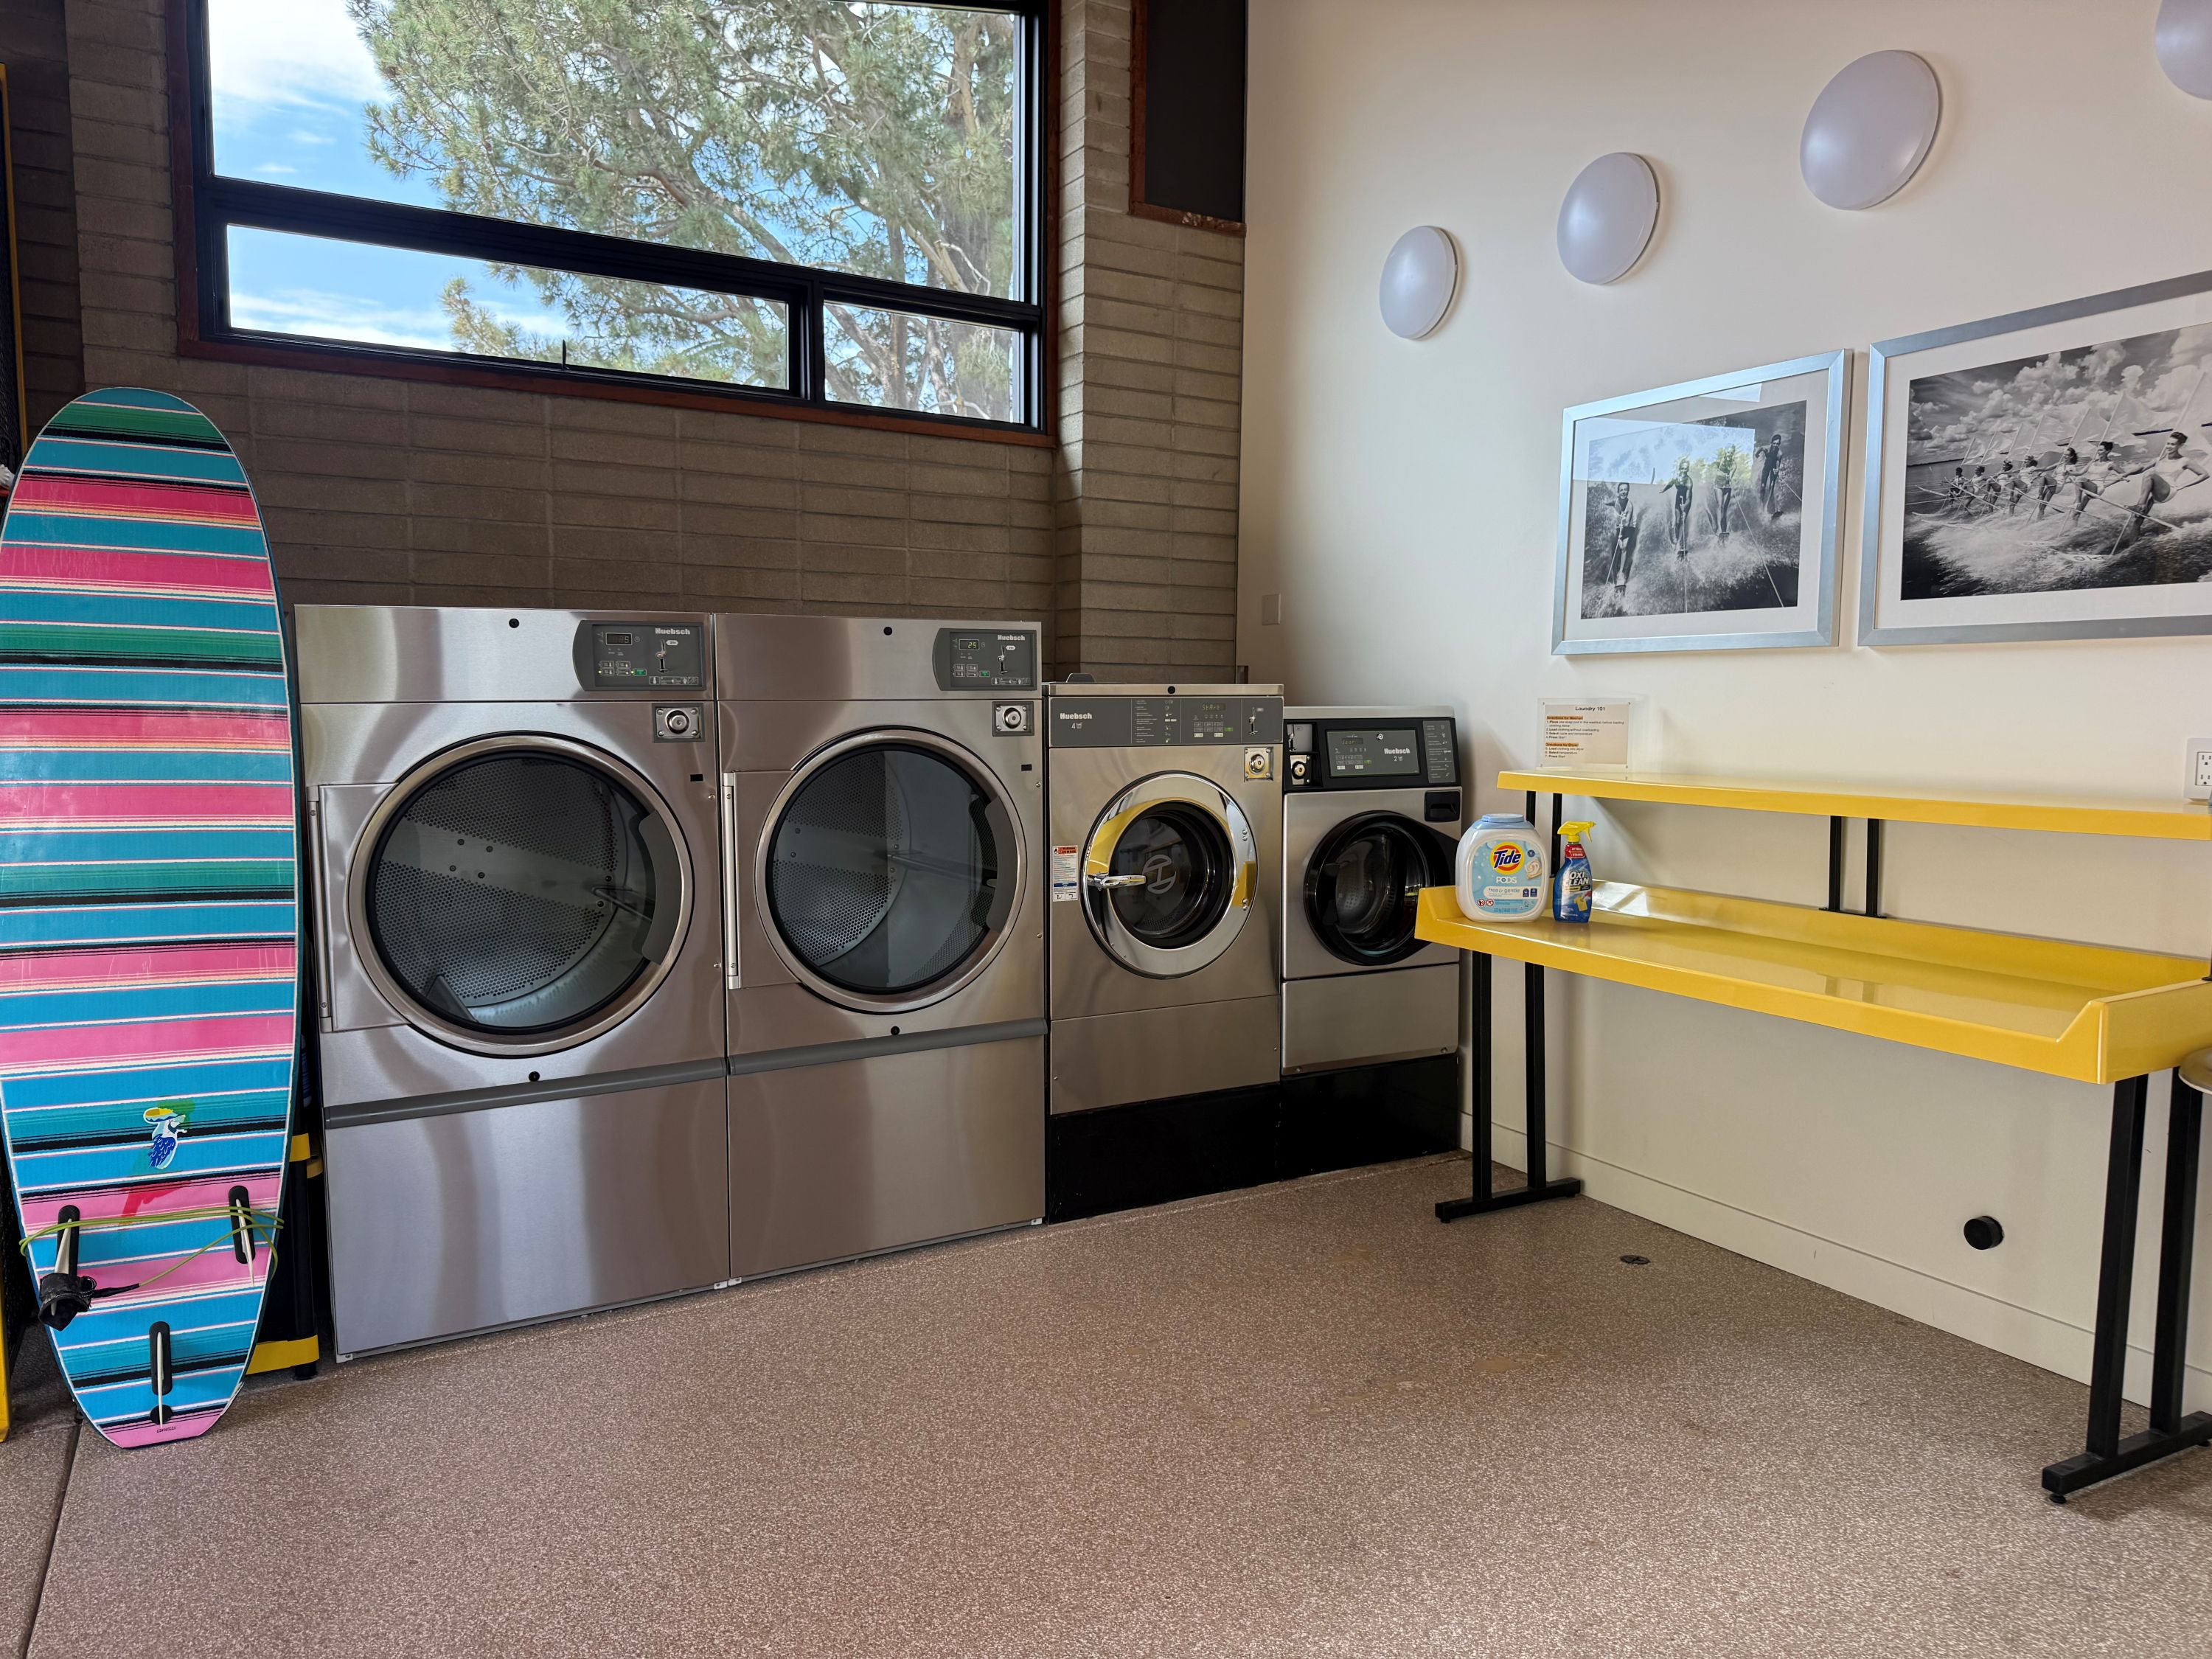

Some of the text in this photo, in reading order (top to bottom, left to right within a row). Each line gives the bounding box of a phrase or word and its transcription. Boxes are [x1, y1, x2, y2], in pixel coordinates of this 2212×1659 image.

[1494, 849, 1522, 869] Tide
[1496, 876, 1517, 884] PODS
[1569, 871, 1585, 880] OXI
